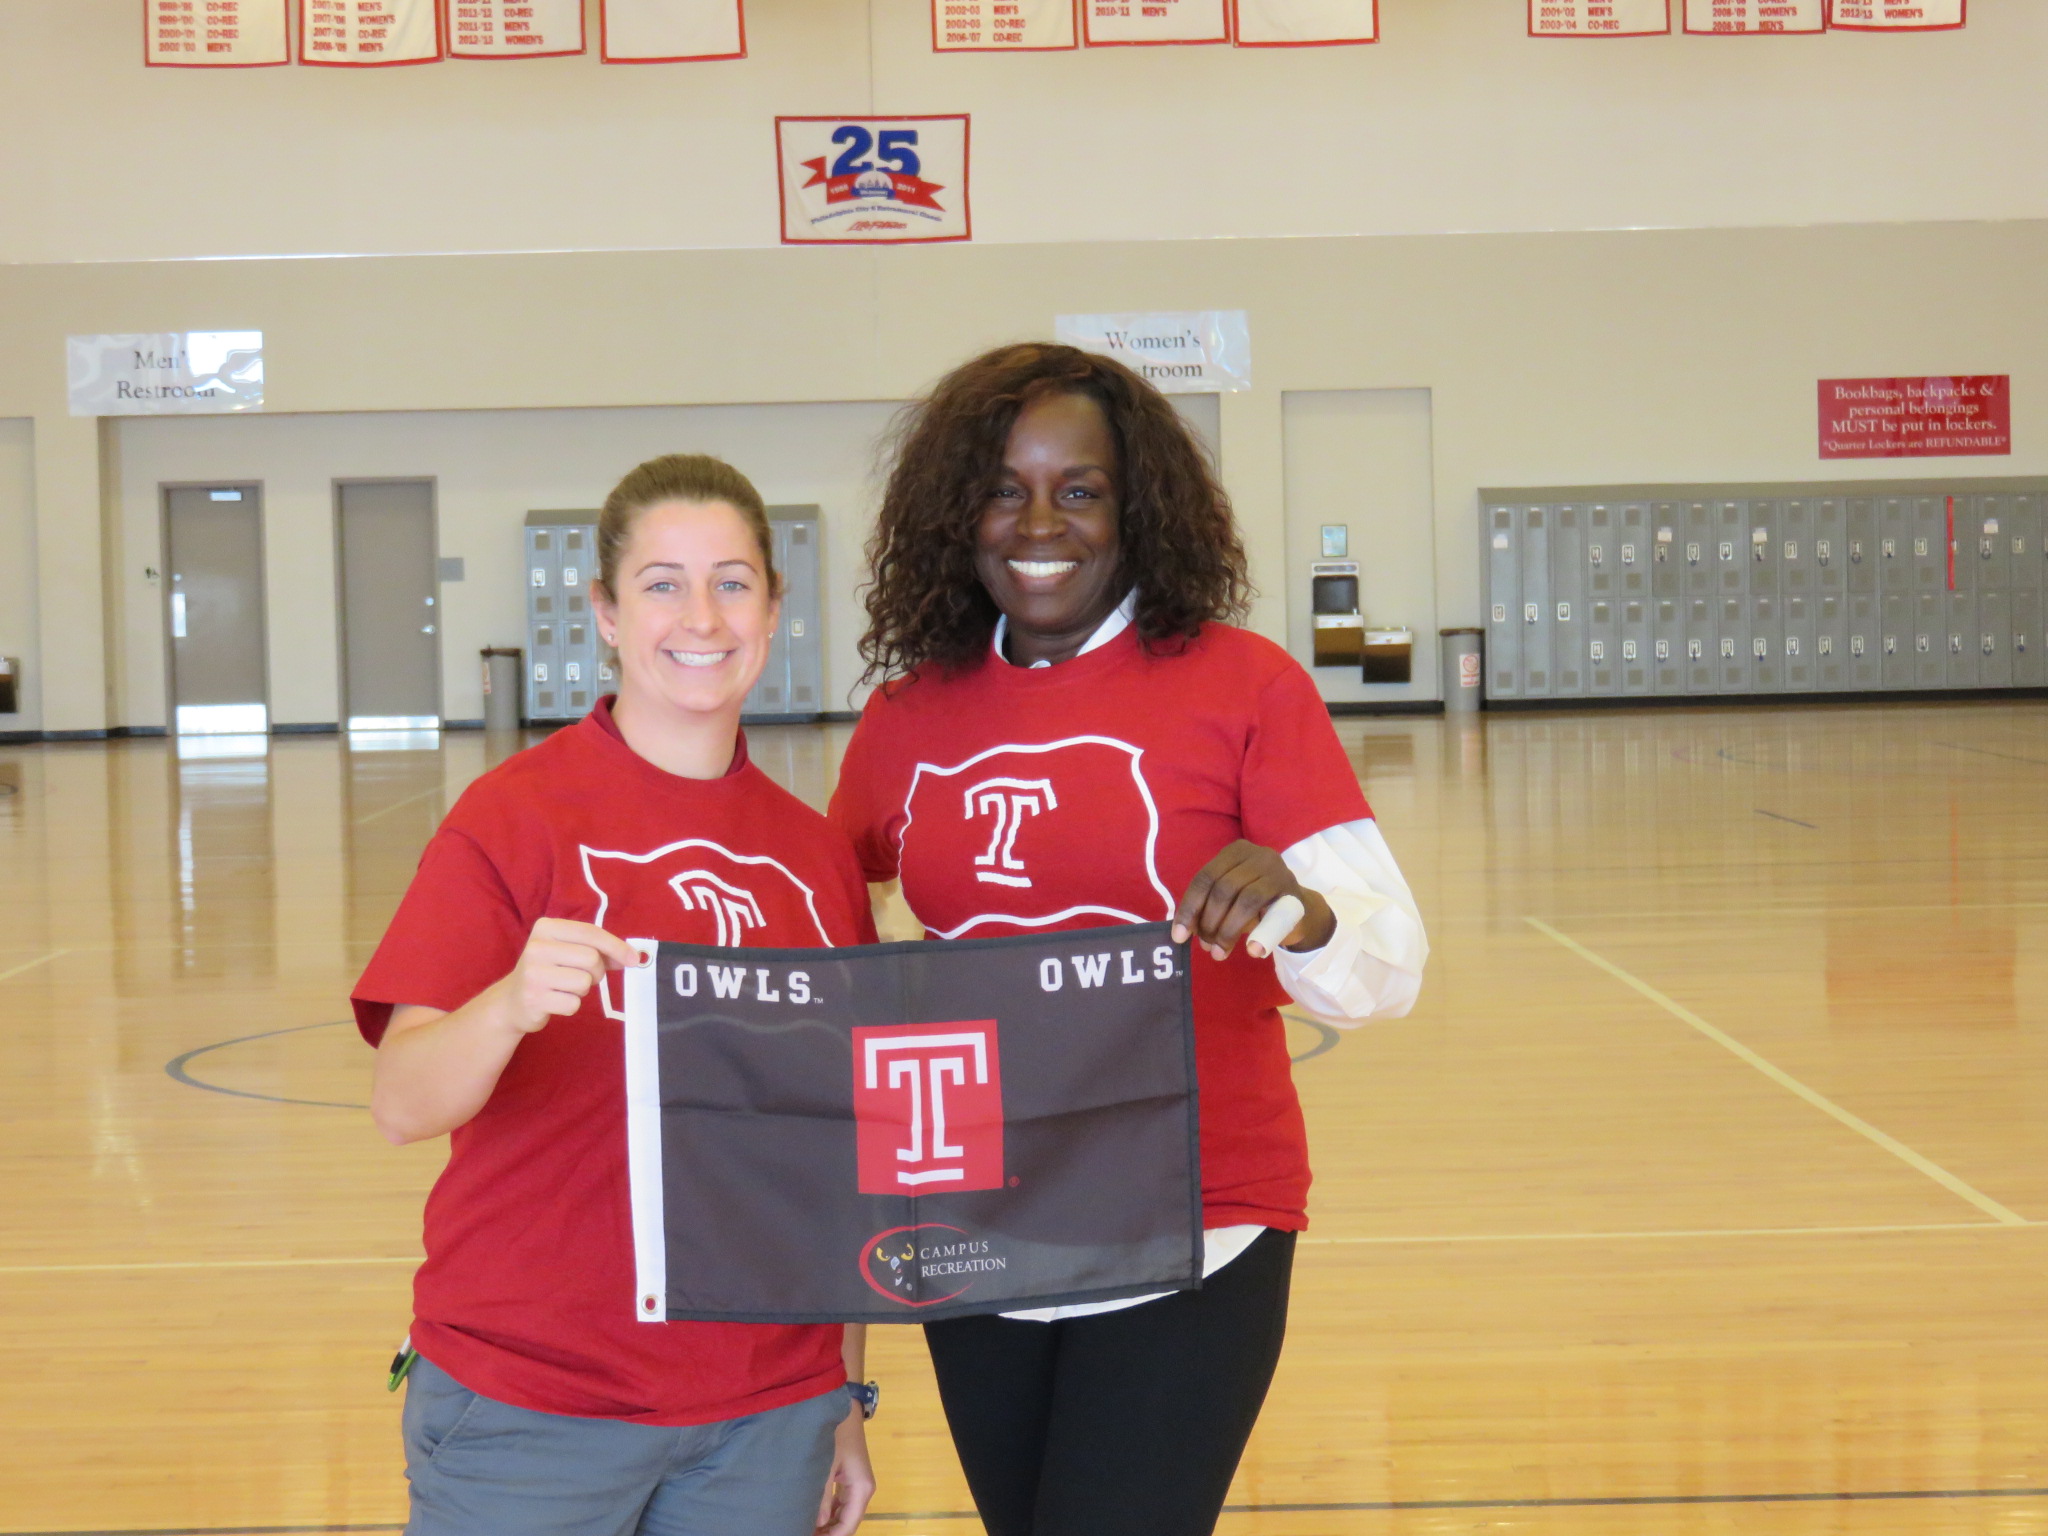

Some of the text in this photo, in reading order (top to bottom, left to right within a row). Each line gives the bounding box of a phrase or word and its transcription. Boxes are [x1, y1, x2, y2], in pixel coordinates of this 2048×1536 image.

[206, 2, 240, 12] CO-REC
[993, 5, 1019, 15] MEN'S
[1142, 7, 1168, 17] MEN'S
[1588, 7, 1614, 17] MEN'S
[1758, 6, 1797, 17] WOMEN'S
[503, 8, 534, 18] CO-REC
[1884, 8, 1923, 19] WOMEN'S
[206, 15, 240, 25] CO-REC
[358, 14, 397, 25] WOMEN'S
[993, 18, 1026, 29] CO-REC
[1588, 20, 1620, 30] CO-REC
[504, 22, 530, 32] MEN'S
[1759, 20, 1785, 31] MEN'S
[206, 29, 240, 39] CO-REC
[358, 28, 388, 39] CO-REC
[993, 33, 1023, 43] CO-REC
[505, 35, 545, 45] WOMEN'S
[207, 42, 233, 52] MEN'S
[358, 42, 384, 52] MEN'S
[831, 125, 922, 177] 25
[1105, 329, 1201, 349] Women's
[134, 350, 189, 370] Men'
[1835, 383, 1994, 401] Bookbags, backpacks &
[1849, 401, 1979, 419] personal belongings
[1832, 417, 1997, 435] MUST be put in lockers.
[1869, 439, 1906, 449] Lockers
[1908, 441, 1923, 449] are
[1040, 946, 1174, 992] OWLS
[675, 963, 811, 1005] OWLS
[864, 1032, 988, 1186] T
[920, 1241, 989, 1260] CAMPUS
[921, 1258, 1007, 1278] RECREATION
